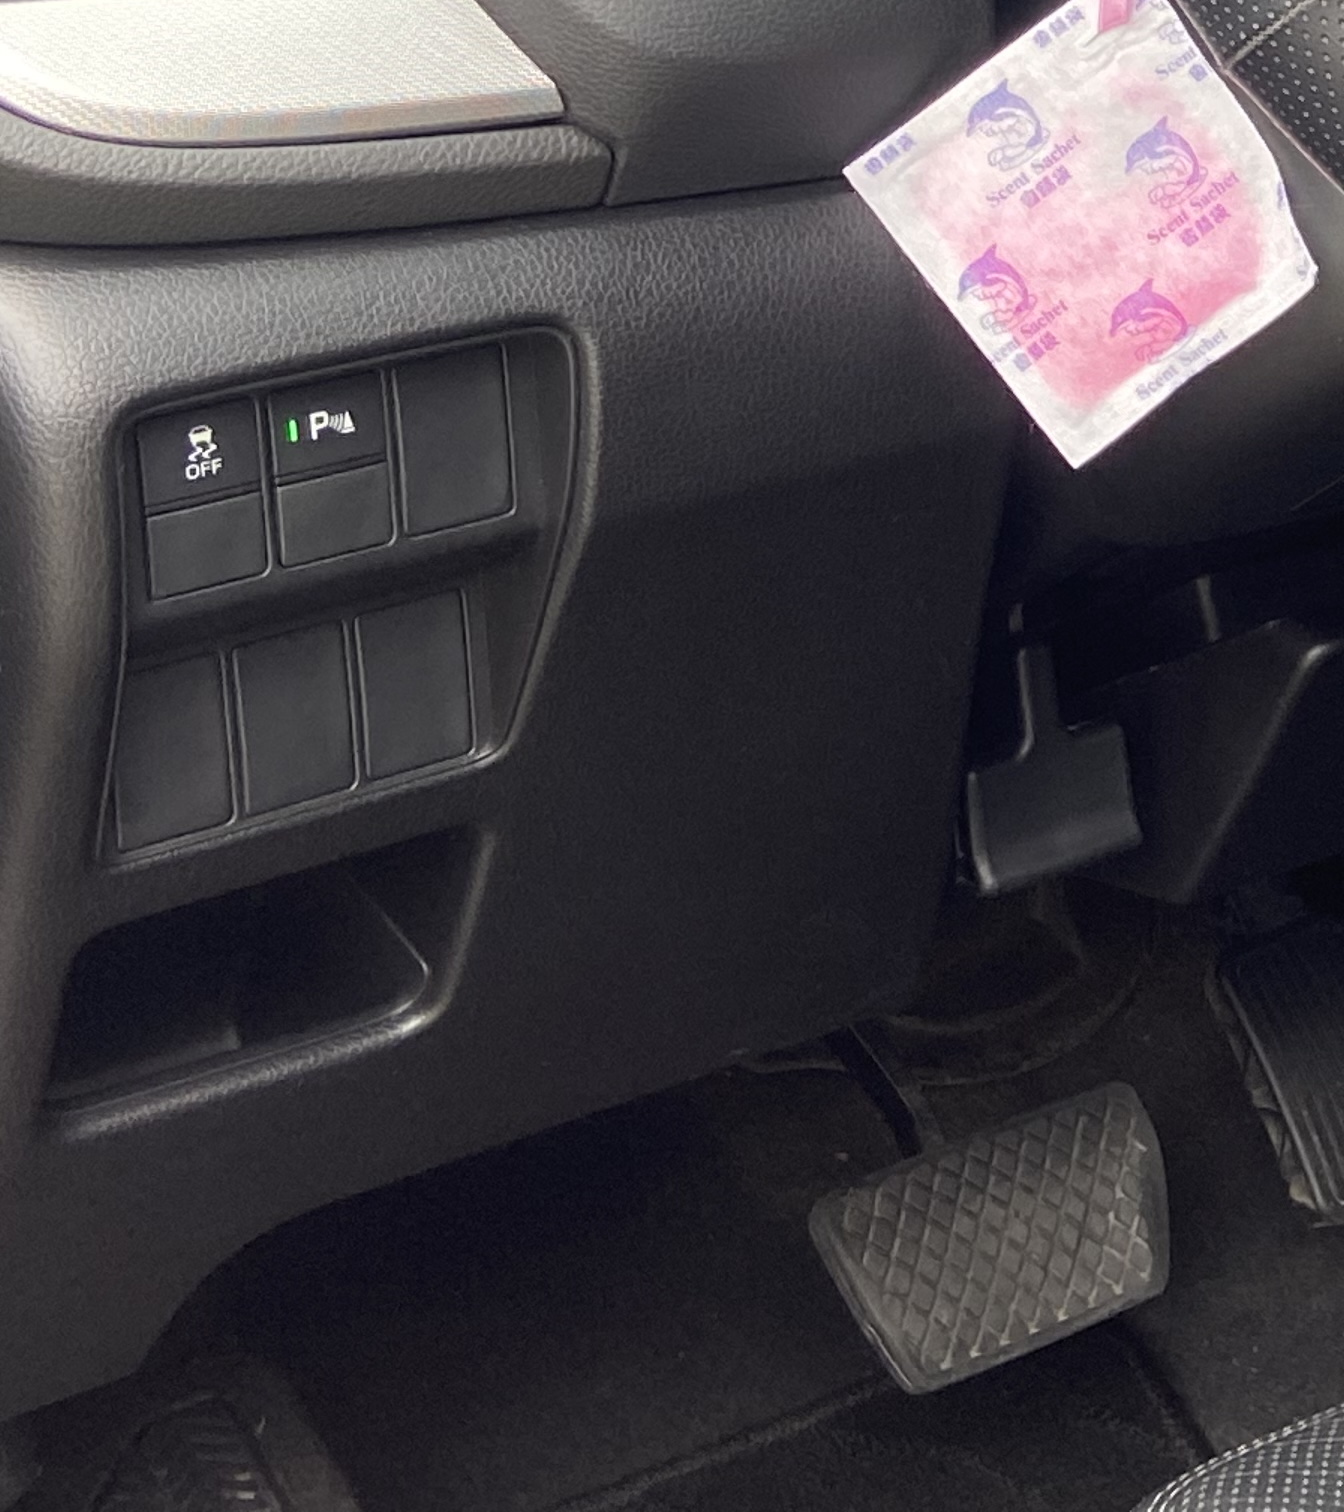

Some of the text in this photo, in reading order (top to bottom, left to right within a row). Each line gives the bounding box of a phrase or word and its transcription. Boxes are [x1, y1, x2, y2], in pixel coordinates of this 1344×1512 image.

[984, 170, 1030, 209] Scent
[1030, 132, 1082, 175] Sachet
[1147, 208, 1190, 246] Scent
[1189, 170, 1240, 213] Sachet
[989, 335, 1022, 365] cent
[1020, 299, 1069, 340] Sachet
[1135, 327, 1229, 401] Scent Sachet
[185, 457, 223, 481] OFF
